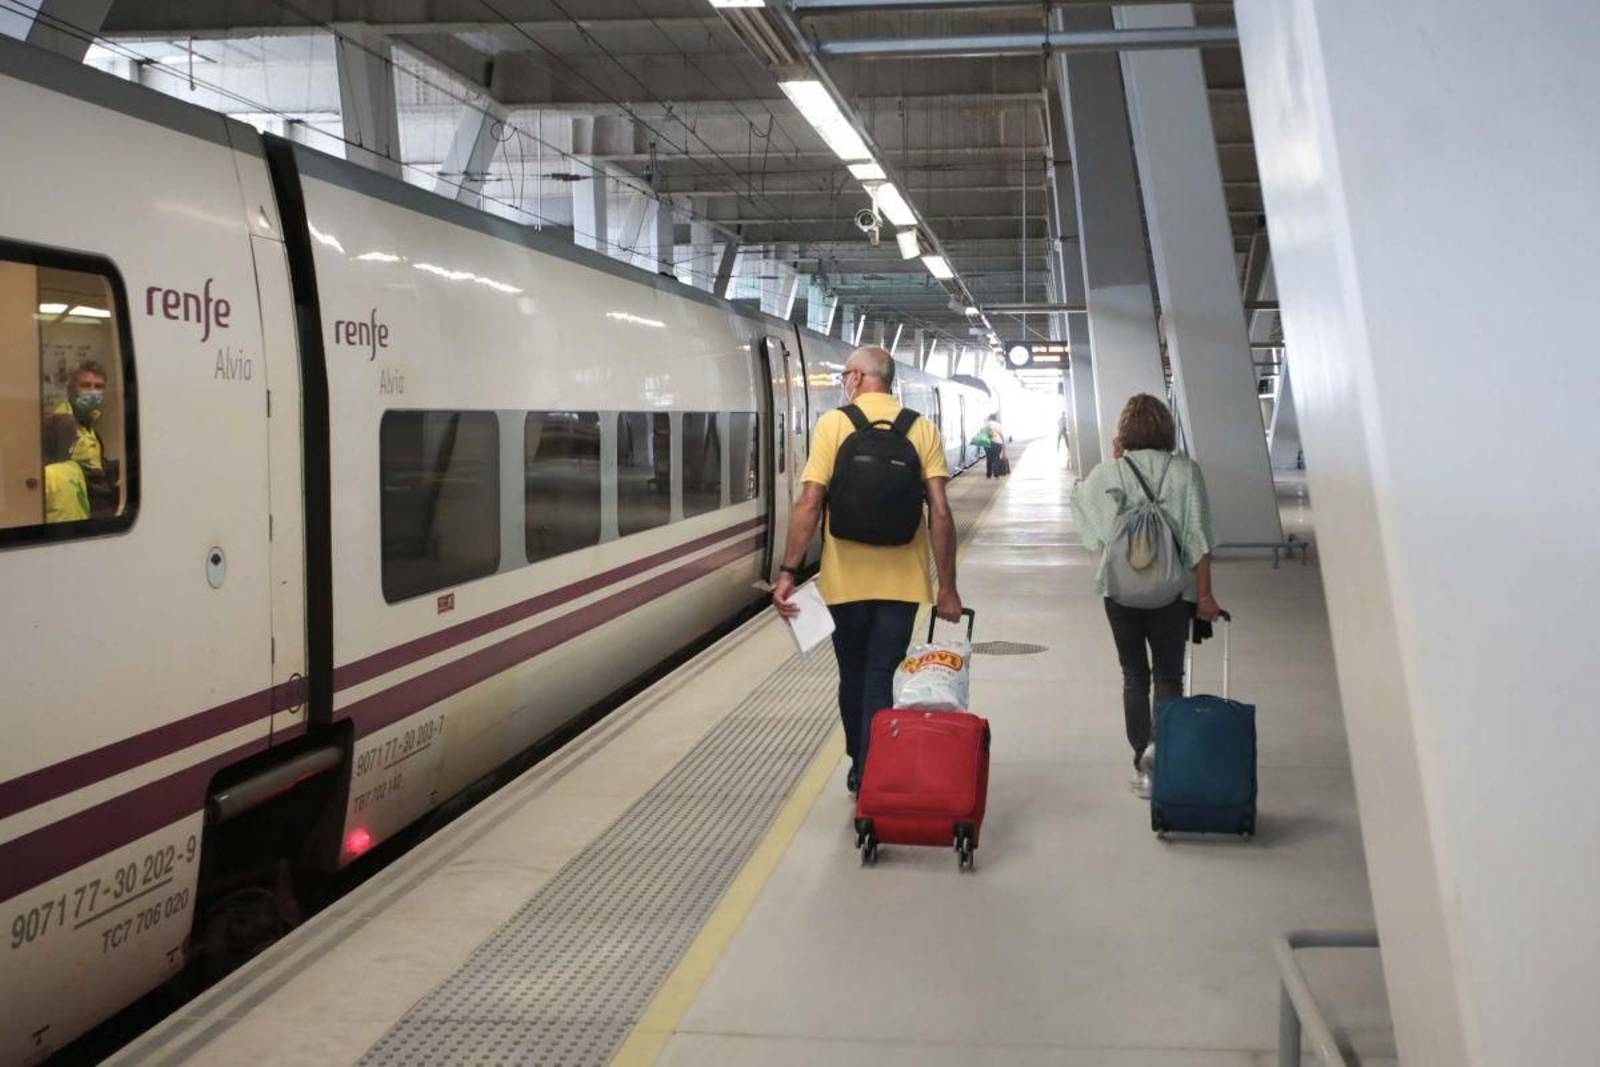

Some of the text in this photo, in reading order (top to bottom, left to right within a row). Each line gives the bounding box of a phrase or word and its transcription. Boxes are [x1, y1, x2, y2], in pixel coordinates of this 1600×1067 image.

[146, 278, 231, 342] renfe
[335, 308, 389, 361] renfe
[214, 346, 252, 381] Alvia
[380, 367, 404, 394] Alvia
[142, 834, 197, 885] 202-9
[102, 887, 189, 953] TC7 706 020
